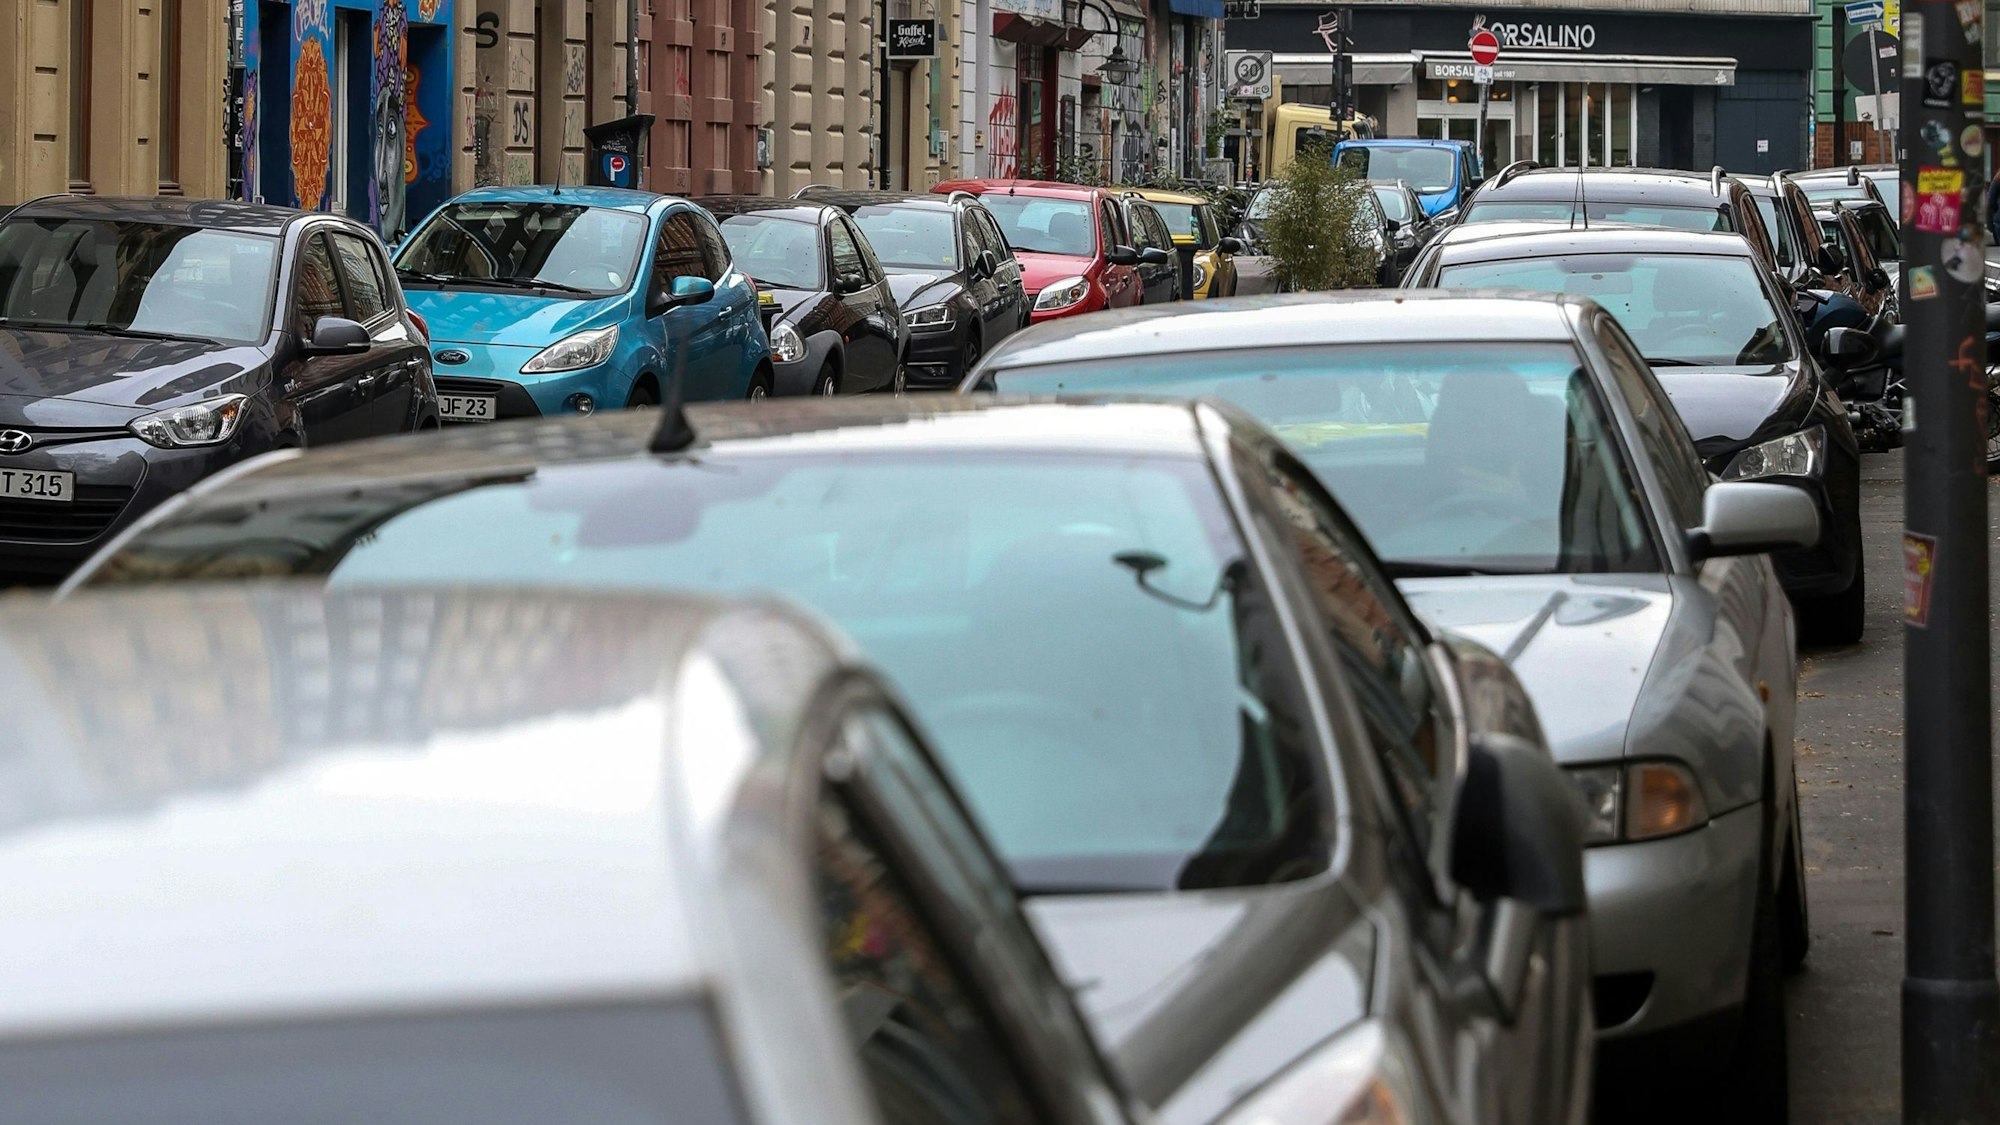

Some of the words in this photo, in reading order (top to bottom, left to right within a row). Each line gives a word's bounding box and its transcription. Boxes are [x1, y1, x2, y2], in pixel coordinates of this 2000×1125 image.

[897, 24, 926, 36] Gaffel
[1240, 63, 1258, 77] 30
[1435, 65, 1474, 77] BORSAL
[441, 398, 462, 415] JF
[466, 399, 487, 416] 23
[2, 471, 16, 493] T
[20, 472, 63, 497] 315
